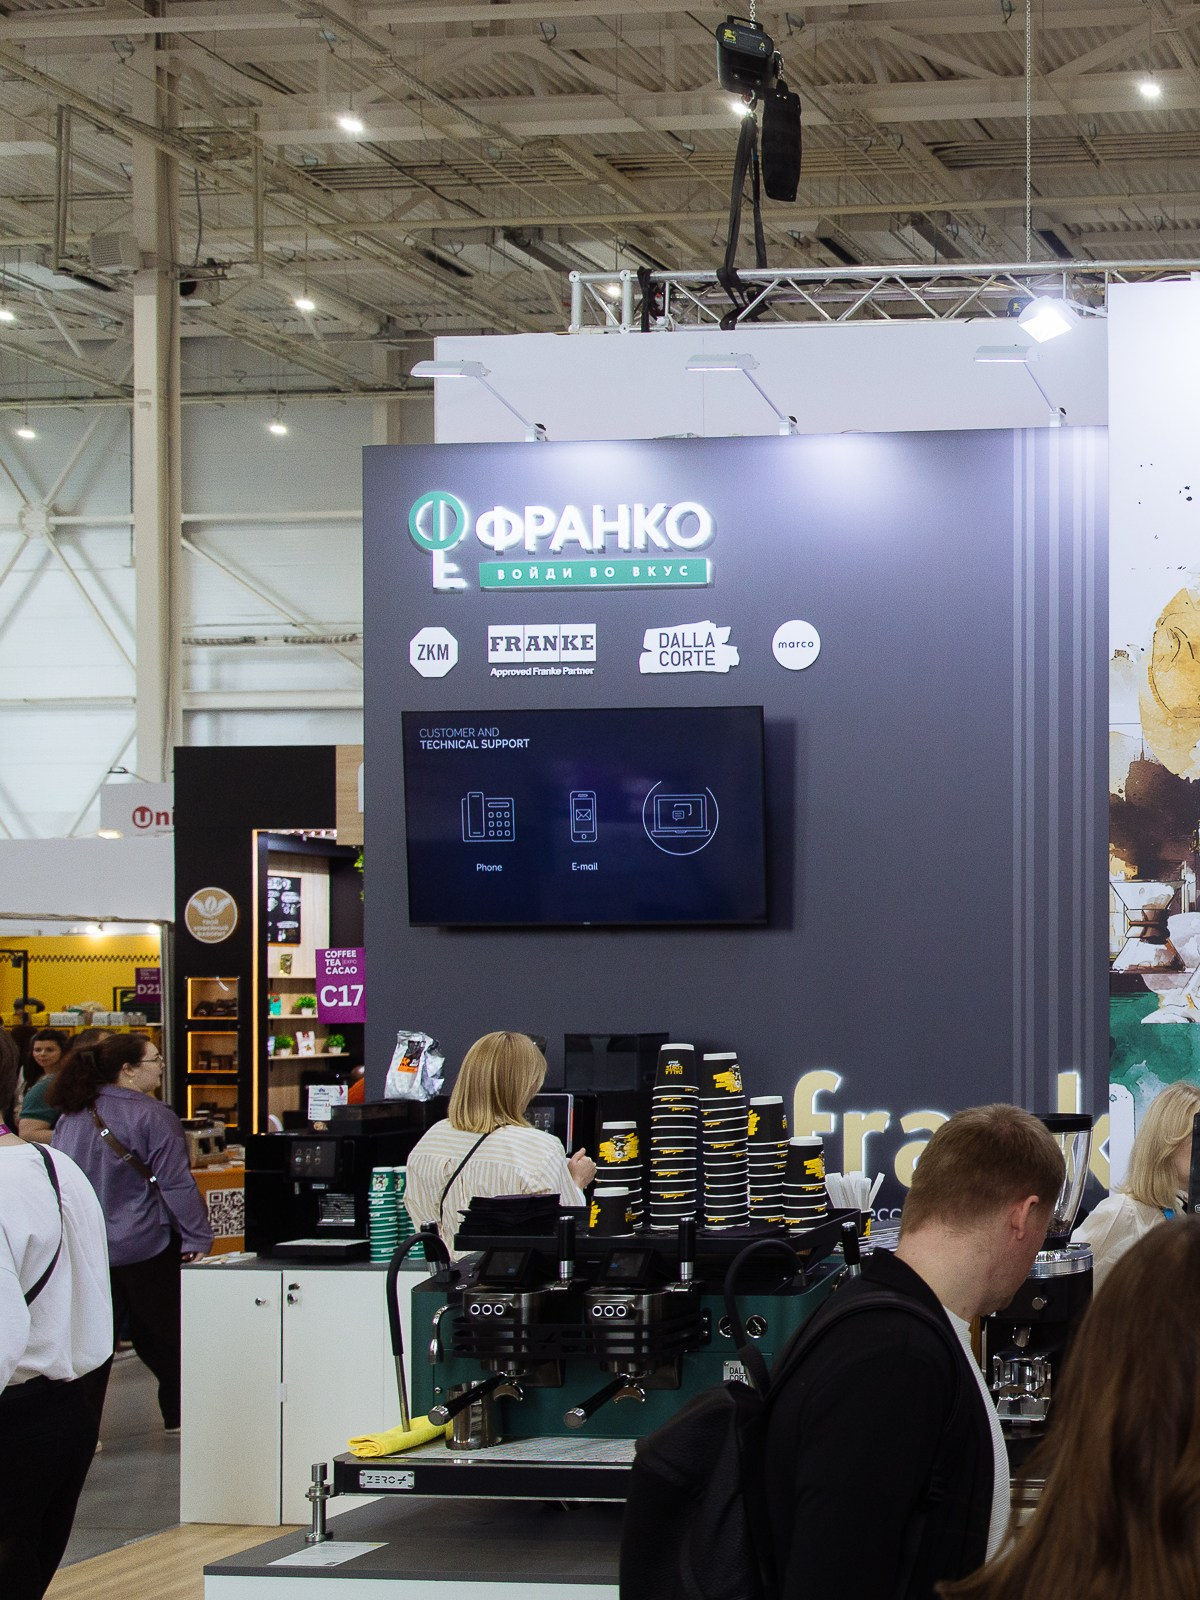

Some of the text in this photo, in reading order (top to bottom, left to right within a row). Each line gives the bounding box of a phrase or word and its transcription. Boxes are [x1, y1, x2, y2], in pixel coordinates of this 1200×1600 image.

[475, 501, 712, 553] ФРАНКО
[497, 564, 690, 581] ВОЙДИ ВО ВКУС
[489, 633, 595, 653] FRANKE
[658, 631, 716, 649] DALLA
[777, 639, 815, 649] marco
[417, 643, 450, 662] ZKM
[659, 649, 717, 667] CORTE
[489, 666, 595, 678] Approved Franke Partner
[419, 726, 500, 738] CUSTOMER AND
[420, 738, 530, 750] TECHNICAL SUPPORT
[476, 862, 598, 872] Phone E-mail
[325, 950, 357, 958] COFFEE
[325, 966, 357, 975] CACAO
[320, 985, 363, 1007] C17
